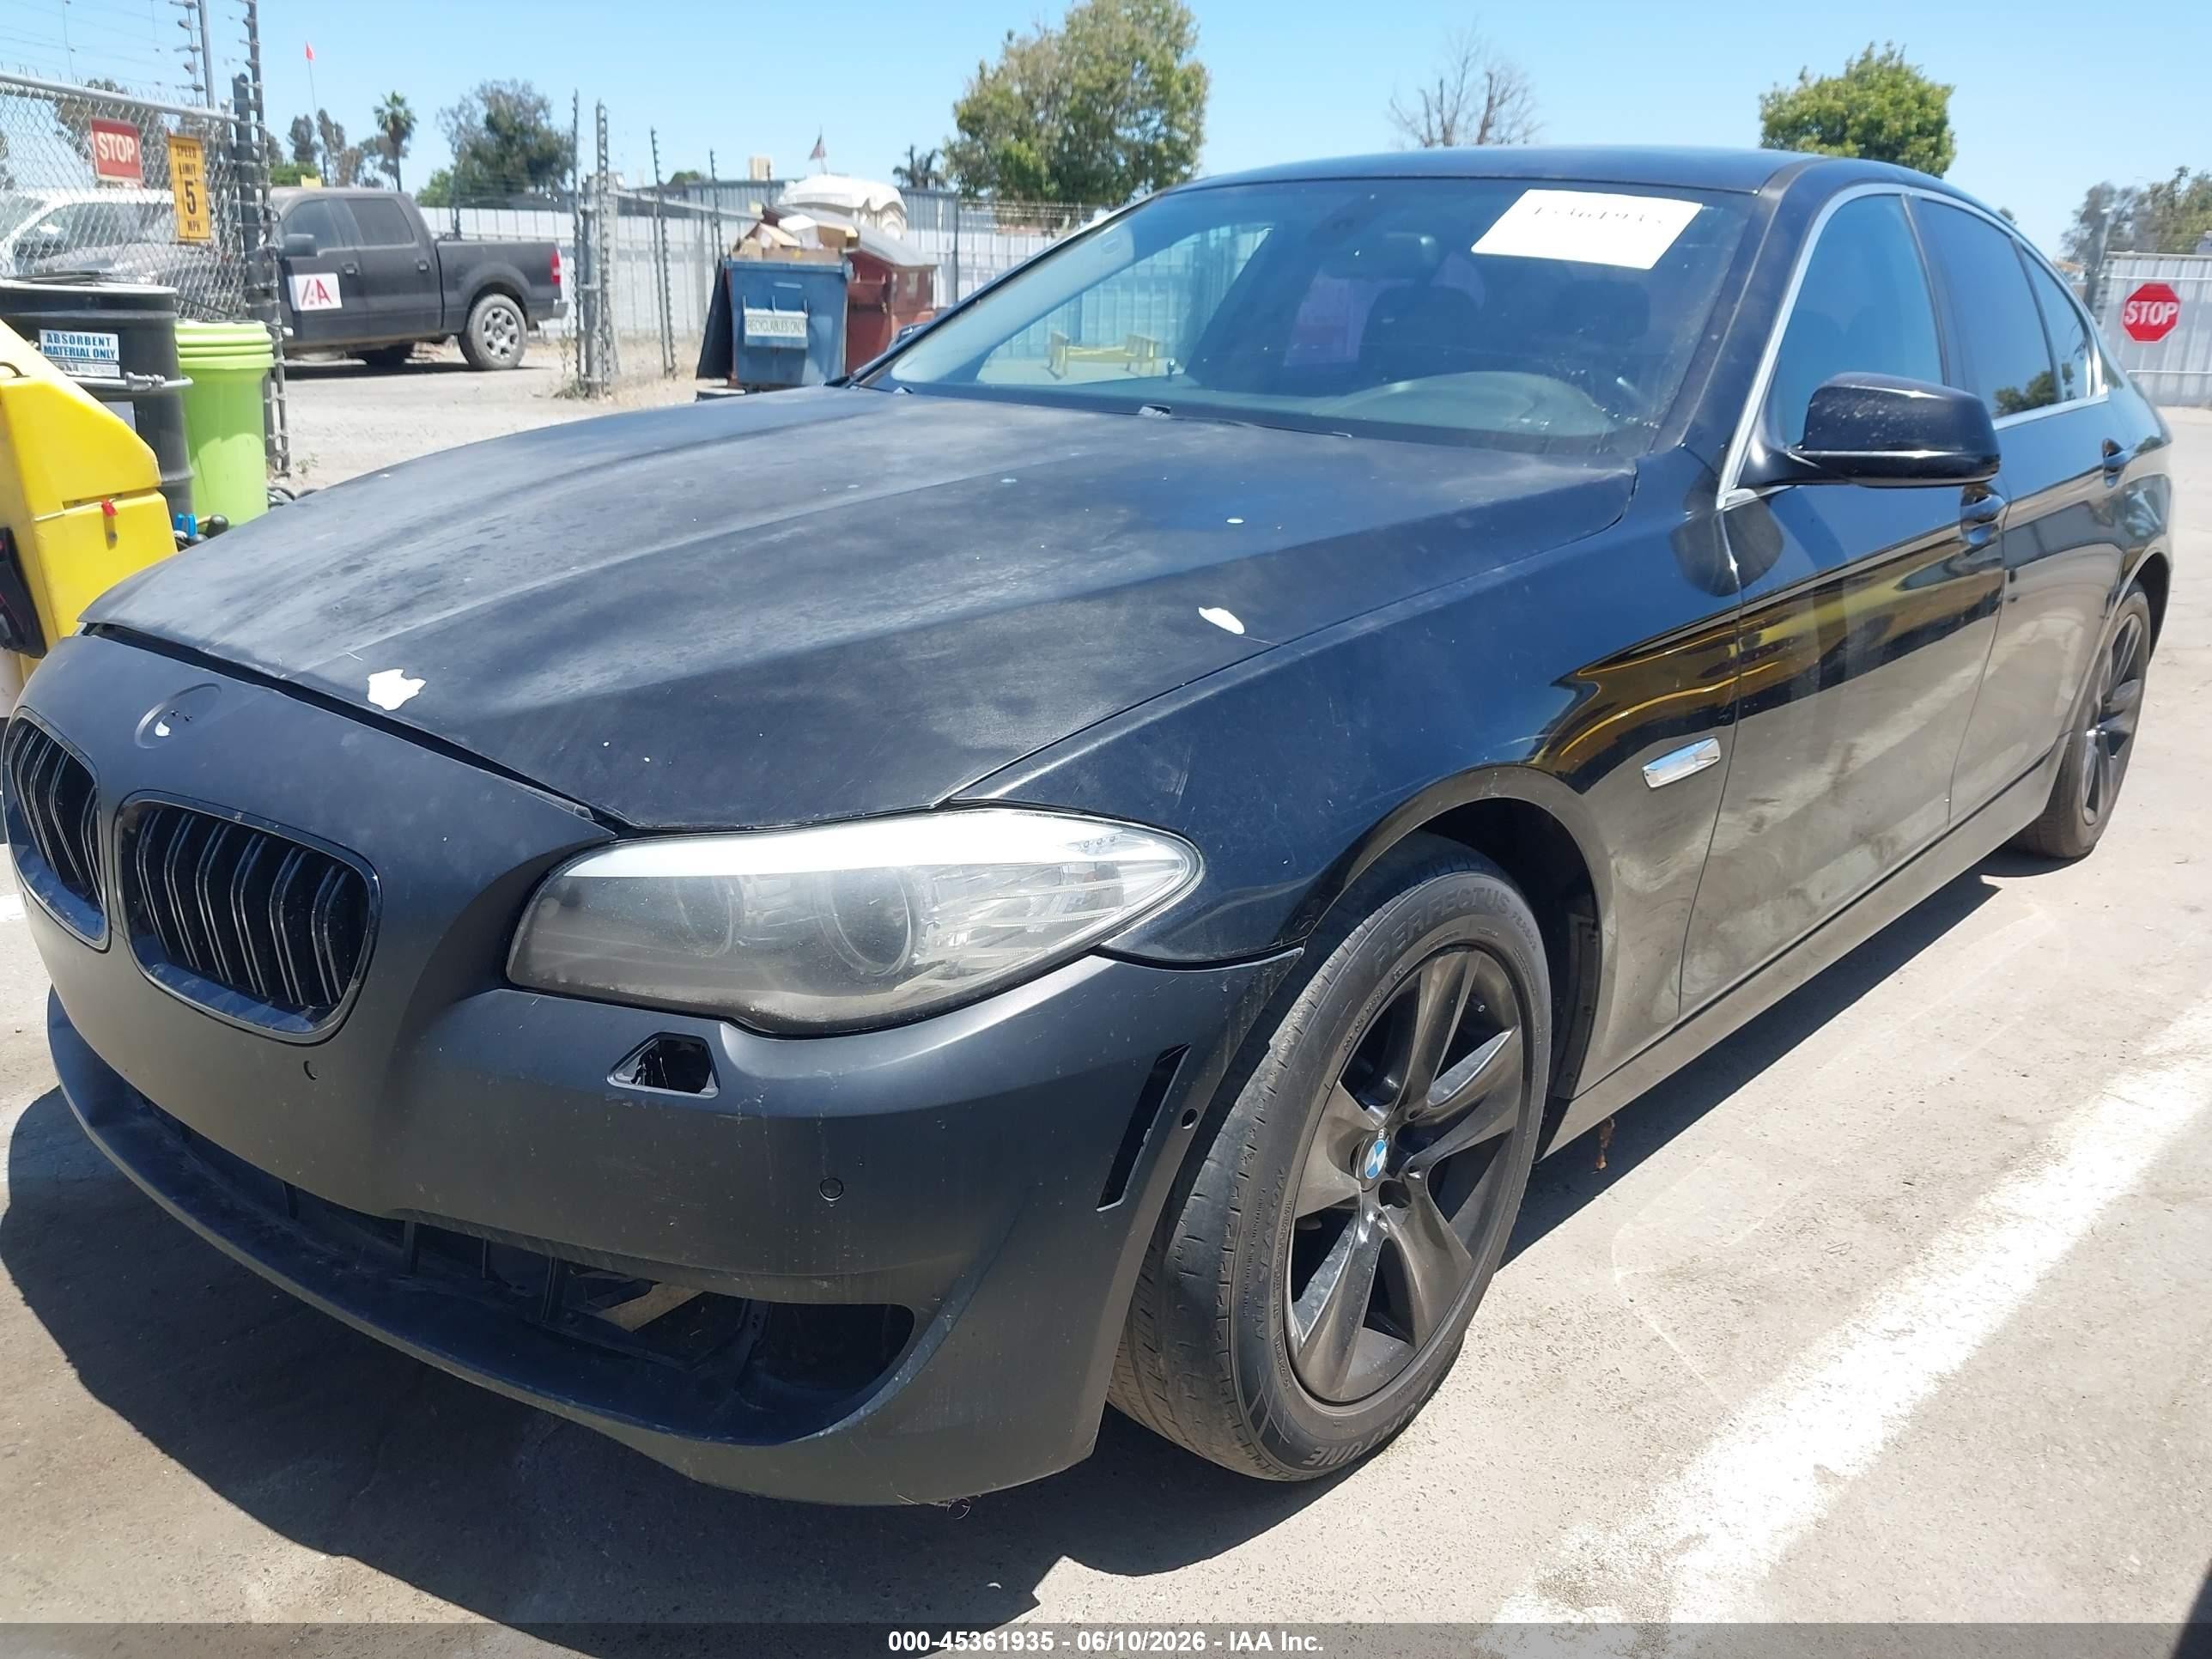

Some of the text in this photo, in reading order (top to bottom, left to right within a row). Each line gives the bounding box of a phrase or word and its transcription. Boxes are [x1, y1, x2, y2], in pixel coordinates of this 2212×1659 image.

[97, 131, 136, 164] STOP
[175, 144, 197, 160] SPEED
[178, 162, 197, 175] LIMIT
[185, 179, 197, 215] 5
[186, 220, 201, 232] MPH
[2124, 301, 2179, 325] STOP
[46, 332, 111, 347] ABSORBENT
[43, 345, 116, 359] MATERIAL ONLY
